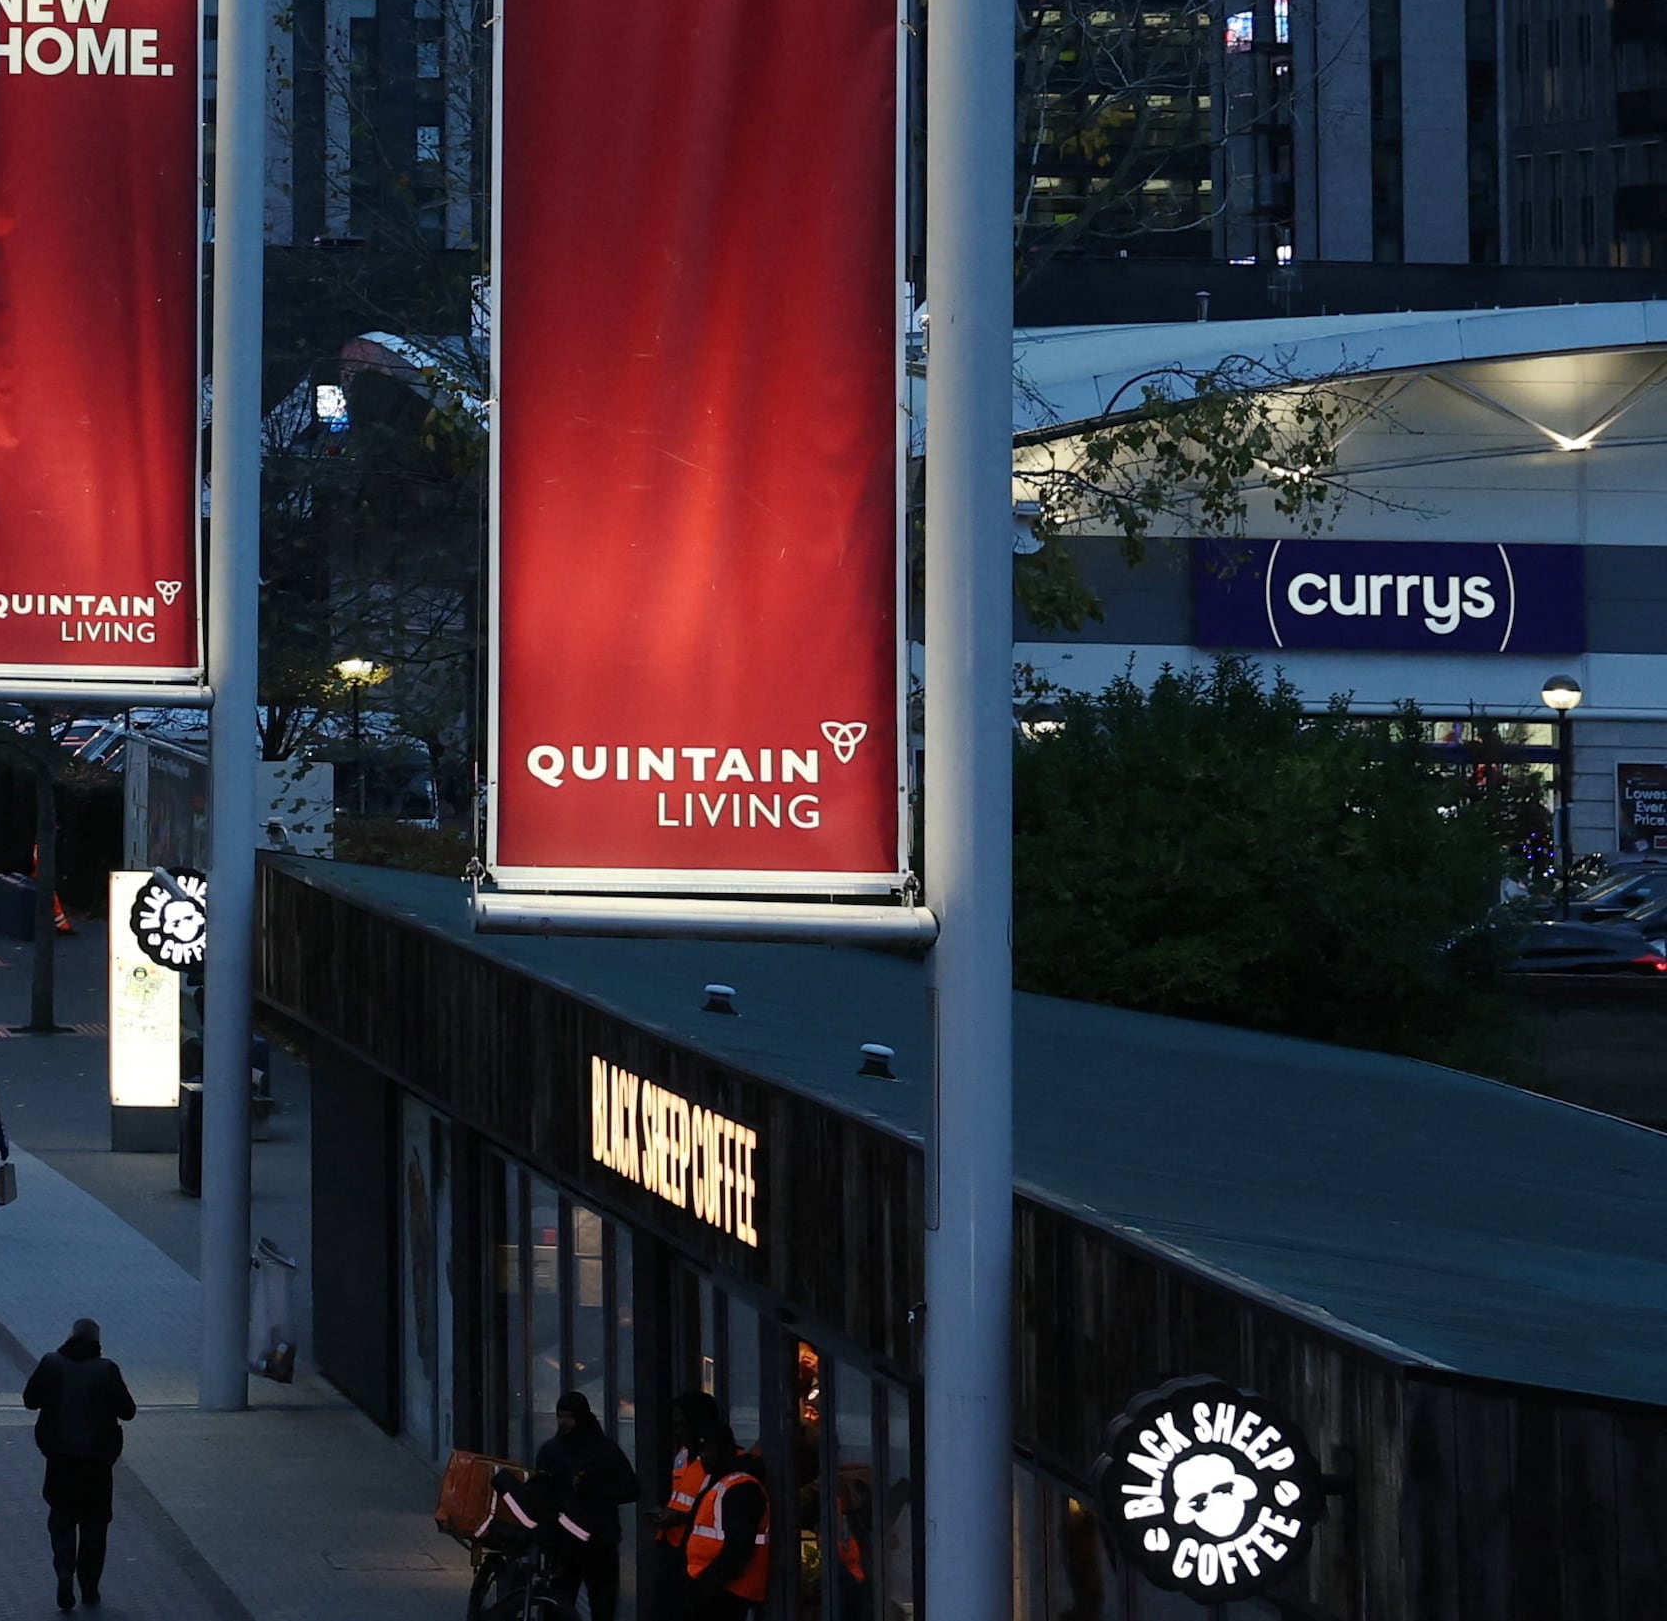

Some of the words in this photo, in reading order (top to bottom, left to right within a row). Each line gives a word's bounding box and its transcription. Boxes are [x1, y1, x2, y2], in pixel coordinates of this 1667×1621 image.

[1287, 571, 1495, 635] currys
[61, 621, 155, 643] LIVING
[526, 745, 819, 788] QUINTAIN
[657, 792, 820, 829] LIVING
[1625, 787, 1667, 800] Lowes
[160, 939, 206, 964] COFF
[592, 1055, 640, 1183] BLACK
[642, 1080, 690, 1209] SHEEP
[692, 1105, 758, 1248] COFFEE
[1121, 1412, 1192, 1520] BLACK
[1192, 1402, 1295, 1471] SHEEP
[1172, 1507, 1301, 1585] COFFEE
